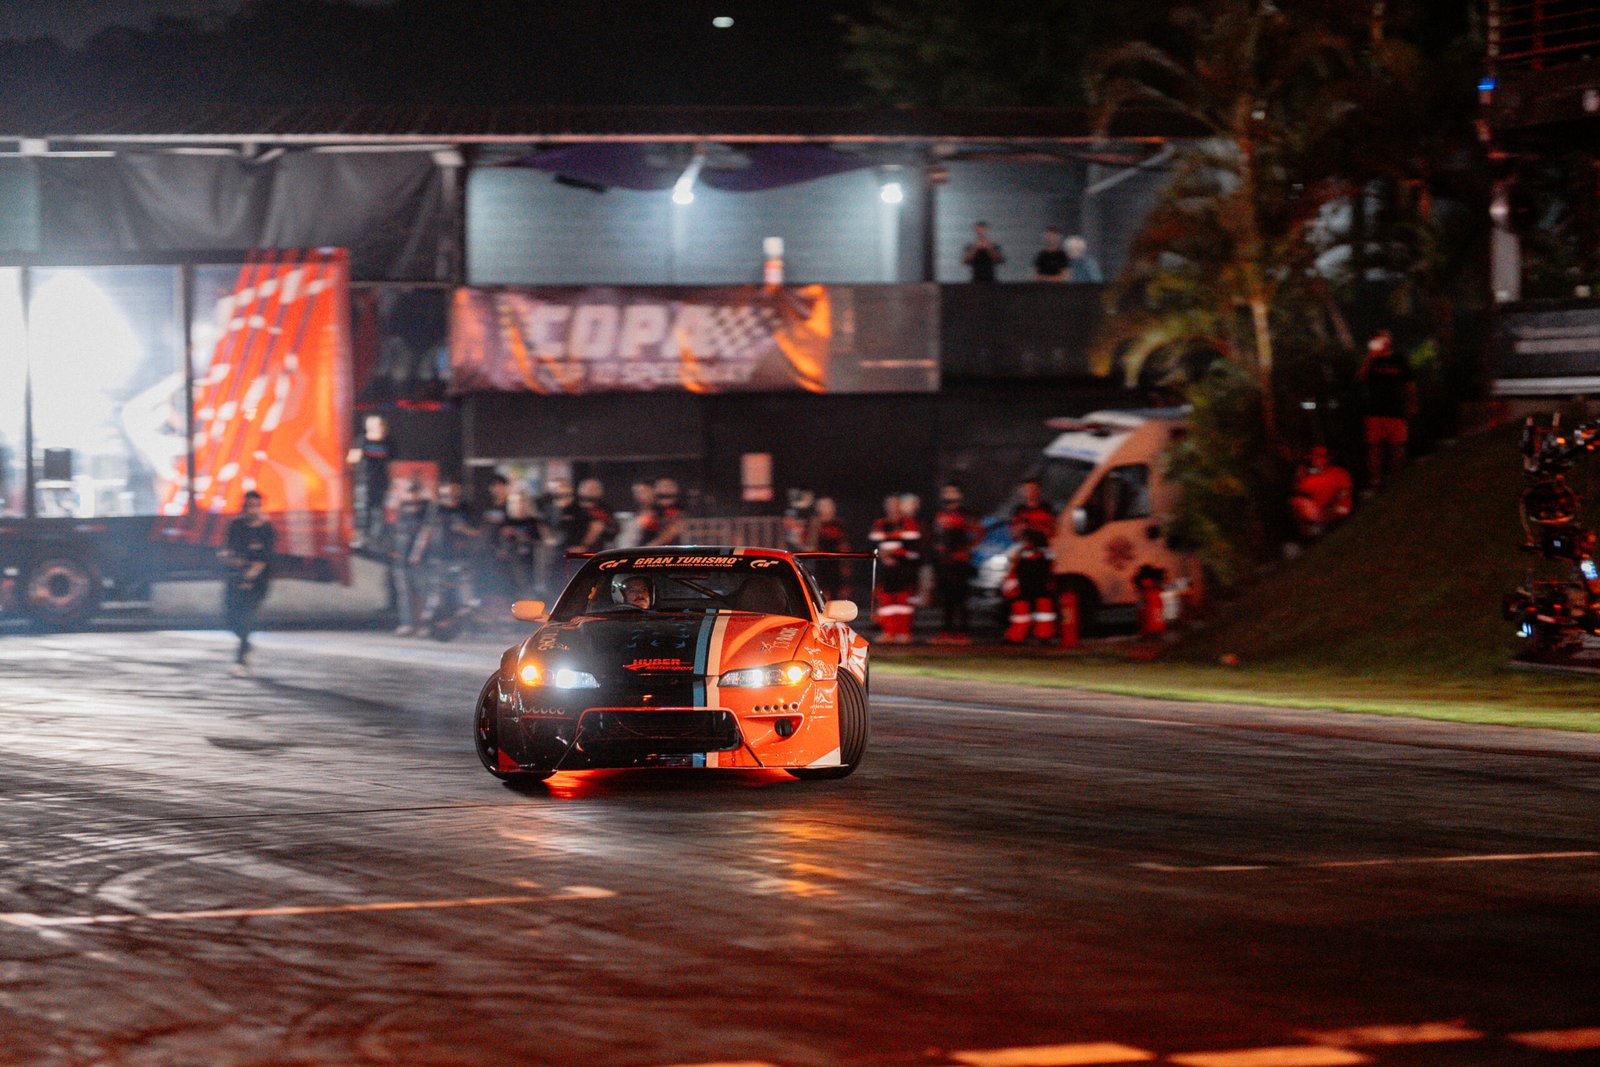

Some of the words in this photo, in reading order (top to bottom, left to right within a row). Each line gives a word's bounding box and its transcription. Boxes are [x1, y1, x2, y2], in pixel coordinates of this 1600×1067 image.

[528, 304, 716, 358] COPA
[634, 556, 674, 565] GRAN
[676, 556, 737, 565] TURISMO
